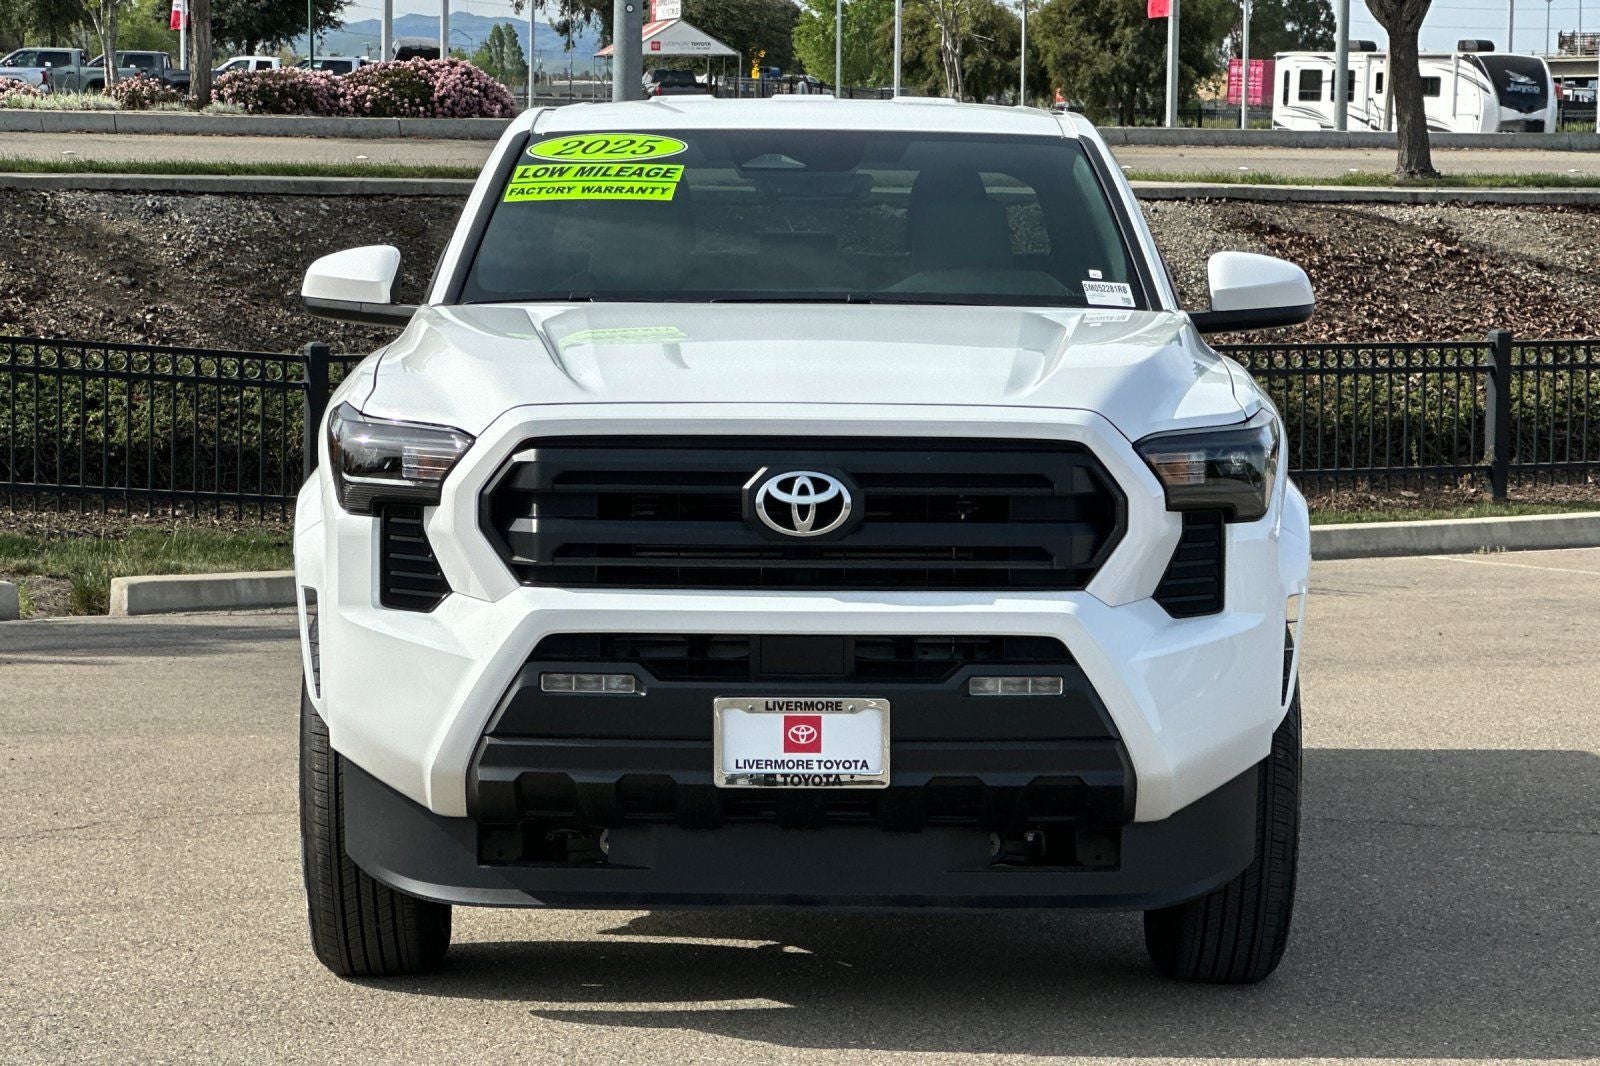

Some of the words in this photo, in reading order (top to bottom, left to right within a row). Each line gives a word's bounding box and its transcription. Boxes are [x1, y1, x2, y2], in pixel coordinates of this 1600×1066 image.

[1506, 83, 1540, 93] Jayco
[551, 139, 663, 156] 2025
[517, 166, 572, 179] LOW
[573, 166, 680, 179] MILEAGE
[508, 186, 576, 197] FACTORY
[581, 185, 671, 195] WARRANTY
[765, 701, 843, 712] LIVERMORE
[735, 759, 813, 770] LIVERMORE
[817, 759, 869, 770] TOYOTA
[780, 774, 843, 786] TOYOTA
